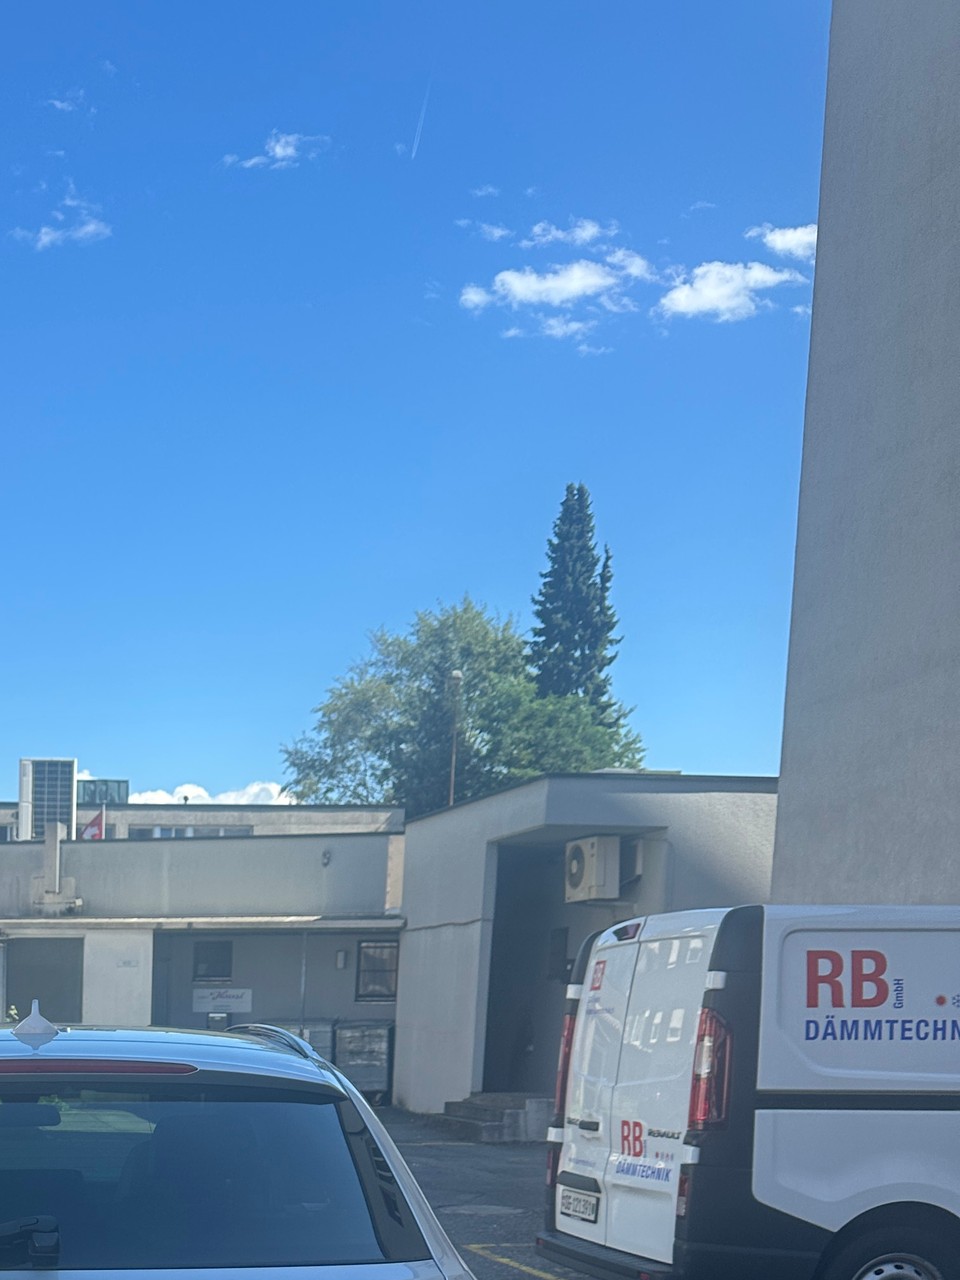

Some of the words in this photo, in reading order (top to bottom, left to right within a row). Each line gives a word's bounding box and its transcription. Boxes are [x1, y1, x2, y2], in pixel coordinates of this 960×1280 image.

[806, 950, 889, 1008] RB
[893, 978, 904, 1009] GmbH
[621, 1119, 644, 1157] RB
[616, 1159, 672, 1182] DÄMMTECHNIK
